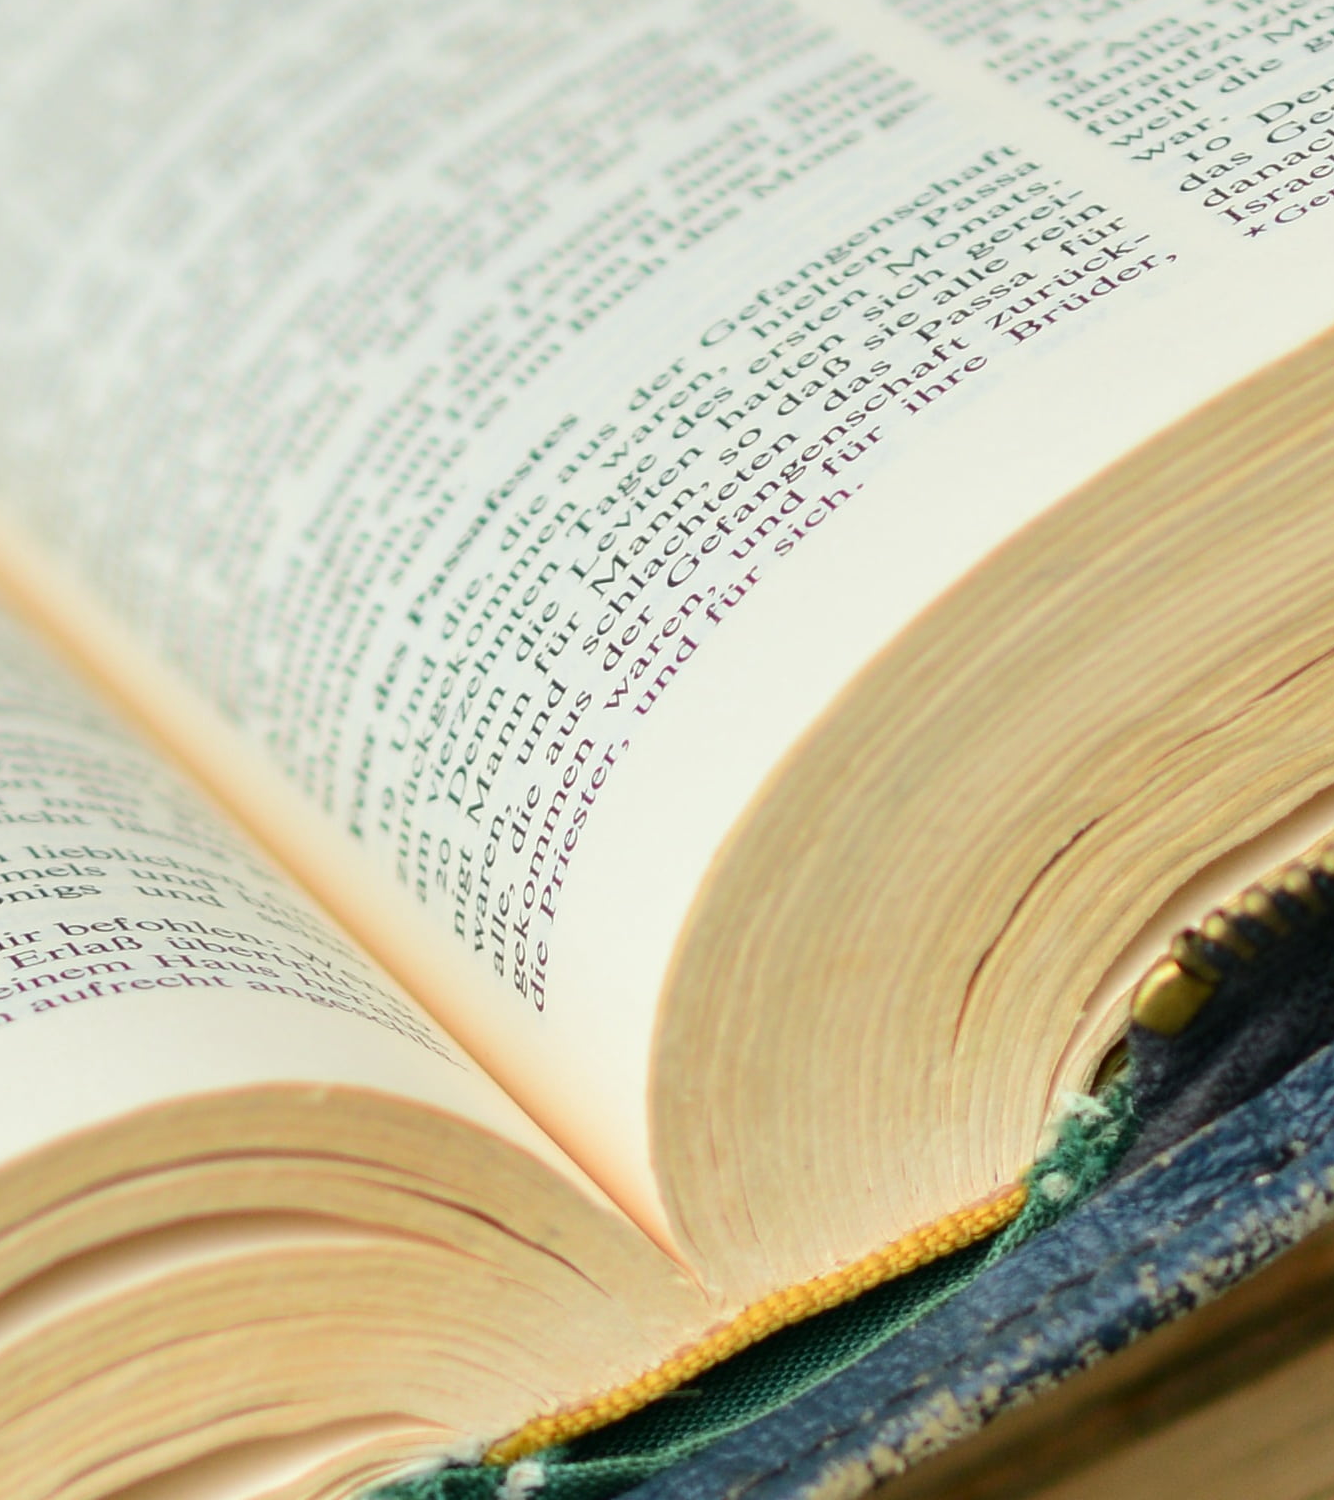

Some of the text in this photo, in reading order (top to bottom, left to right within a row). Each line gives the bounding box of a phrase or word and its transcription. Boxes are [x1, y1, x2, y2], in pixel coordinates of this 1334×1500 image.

[1178, 151, 1254, 193] das
[434, 189, 1084, 890] 20 Denn die Leviten hatten sich gerei-
[450, 203, 1109, 939] nigt Mann für Mann, so daß sie alle rein
[473, 215, 1125, 953] waren, und schlachteten das Passa für
[489, 233, 1151, 978] alle, die aus der Gefangenschaft zurück-
[511, 253, 1178, 1000] gekommen waren, und für ihre Brüder,
[129, 868, 219, 894] und
[528, 482, 865, 1014] die Priester, und für sich.
[6, 934, 144, 971] Erlaß
[29, 971, 234, 1014] aufrecht
[135, 885, 227, 910] und
[150, 953, 282, 980] Haus
